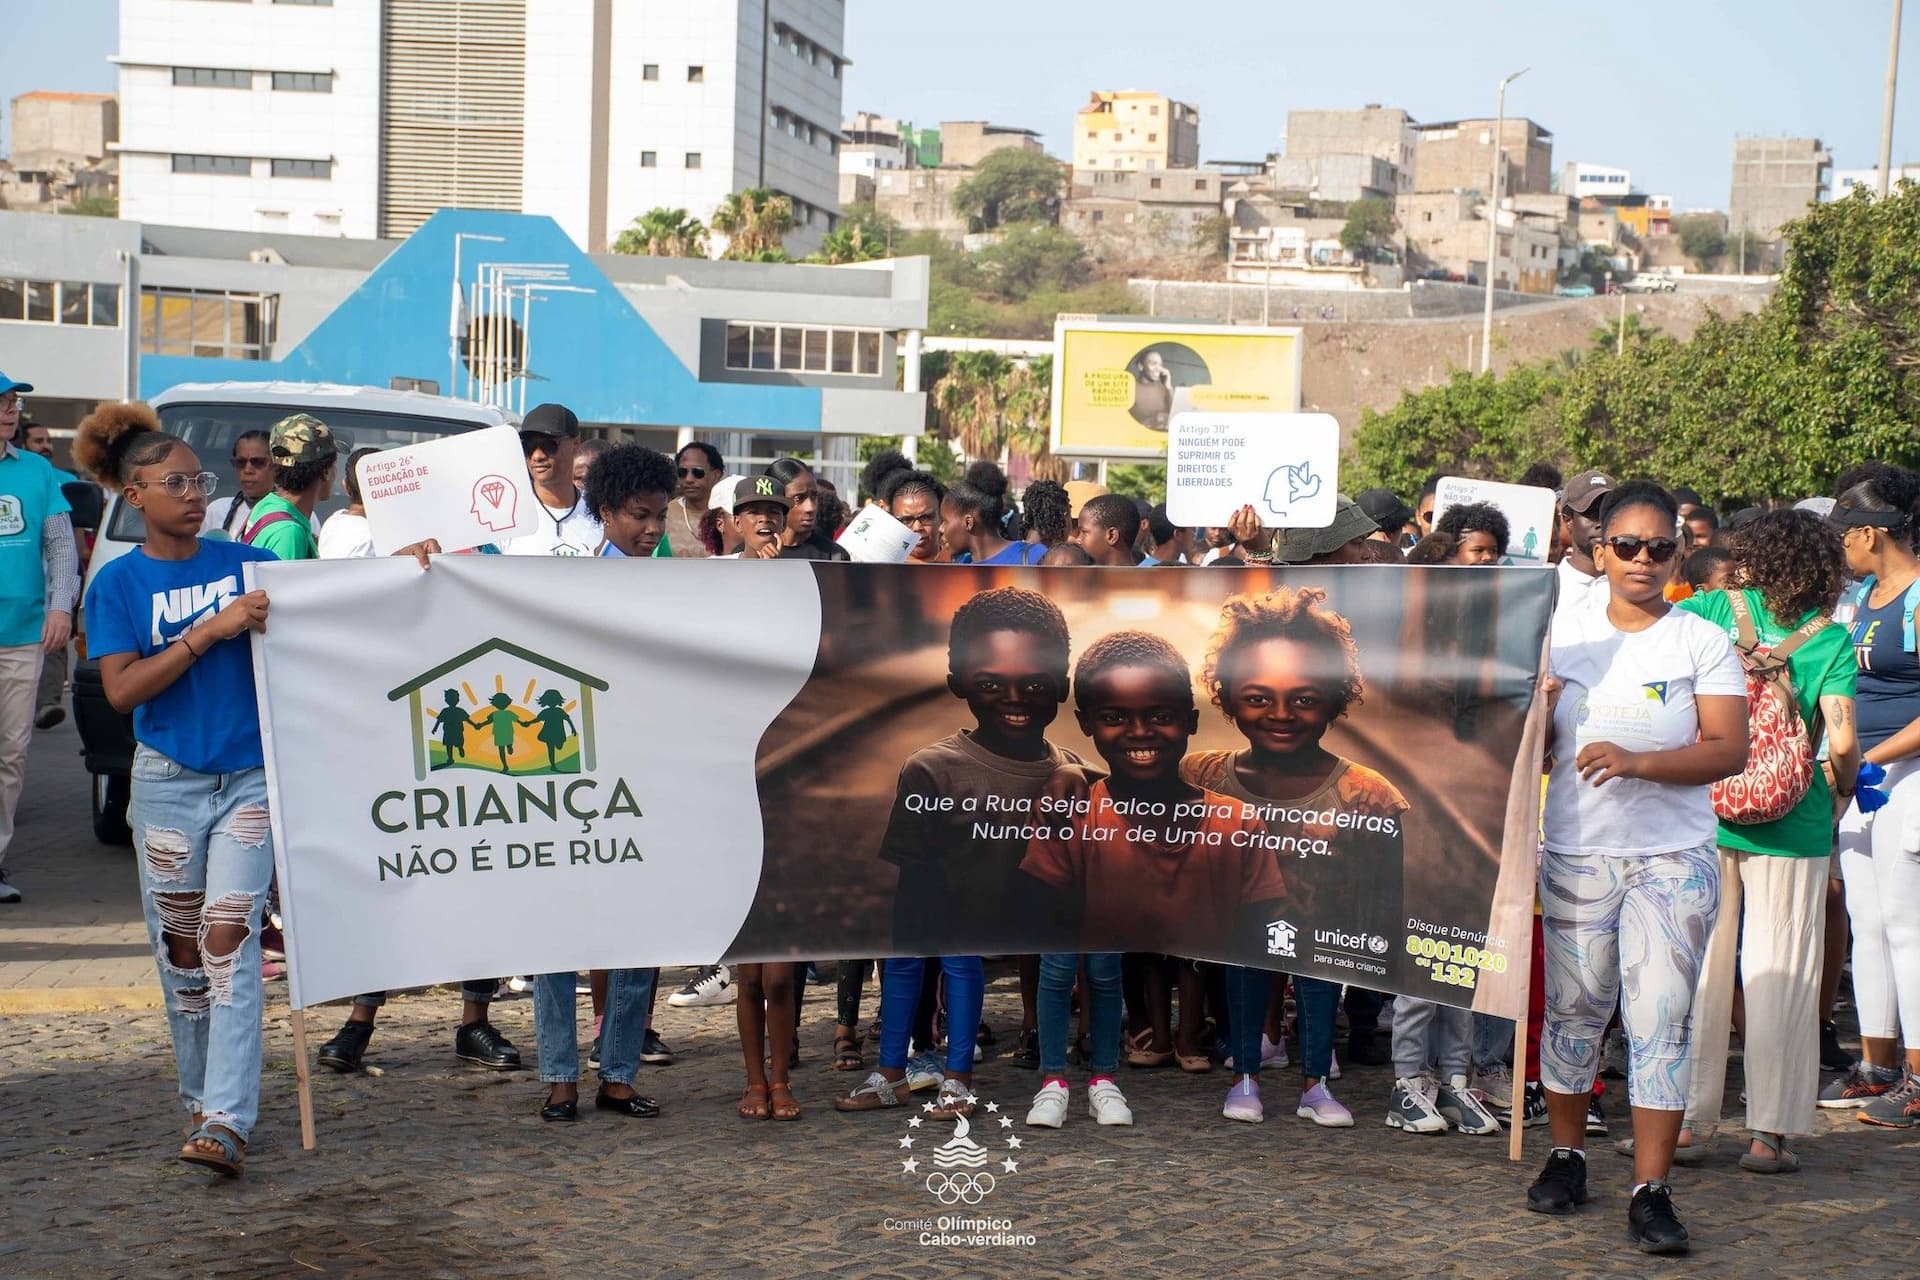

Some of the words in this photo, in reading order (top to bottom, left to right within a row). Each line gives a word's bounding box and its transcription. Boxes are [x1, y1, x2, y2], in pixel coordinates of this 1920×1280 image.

[1178, 424, 1210, 436] Artigo
[1178, 435, 1219, 447] NINGUÉM
[1222, 438, 1246, 447] PODE
[1178, 451, 1221, 461] SUPRIMIR
[1223, 451, 1236, 461] OS
[366, 461, 397, 474] Artigo
[368, 467, 415, 487] EDUCAÇÃO
[416, 466, 430, 477] DE
[1177, 464, 1218, 473] DIREITOS
[1220, 464, 1226, 473] E
[371, 482, 422, 499] QUALIDADE
[1176, 477, 1233, 487] LIBERDADES
[371, 777, 644, 834] CRIANÇA
[904, 793, 954, 814] Que
[961, 796, 978, 812] a
[985, 794, 1031, 813] Rua
[1039, 795, 1091, 819] Seja
[1098, 797, 1166, 817] Palco
[1173, 802, 1233, 822] para
[1240, 802, 1401, 838] Brincadeiras,
[971, 822, 1051, 841] Nunca
[1059, 825, 1074, 841] o
[1082, 823, 1118, 842] Lar
[1125, 824, 1157, 843] de
[1165, 826, 1222, 847] Uma
[1230, 829, 1332, 858] Criança.
[378, 844, 457, 882] NÃO
[471, 839, 493, 872] É
[506, 841, 556, 869] DE
[569, 837, 644, 865] RUA
[1406, 918, 1449, 936] Disque
[1314, 928, 1368, 950] unicef
[1313, 954, 1333, 965] para
[1334, 957, 1355, 969] cada
[1356, 961, 1387, 976] criança
[1406, 935, 1507, 974] 8001020
[1431, 962, 1476, 989] 132
